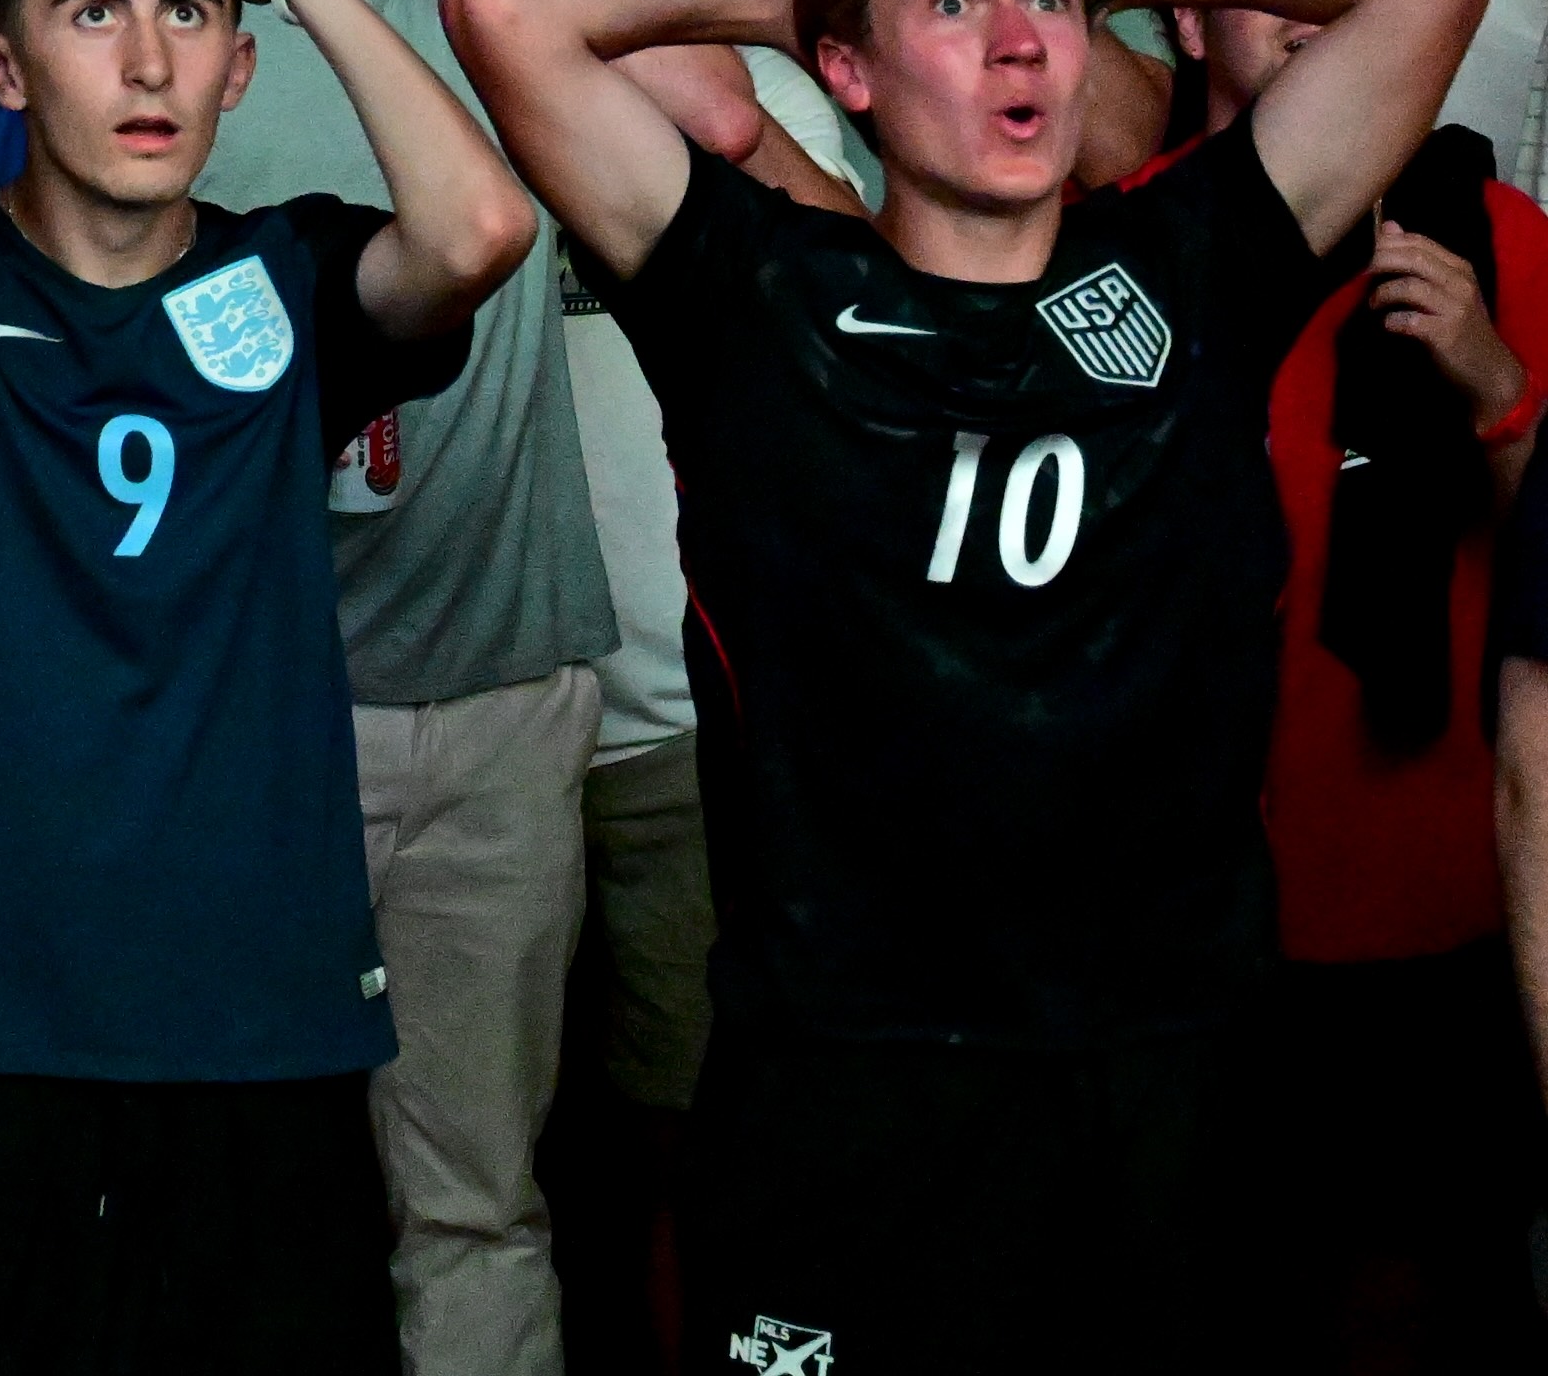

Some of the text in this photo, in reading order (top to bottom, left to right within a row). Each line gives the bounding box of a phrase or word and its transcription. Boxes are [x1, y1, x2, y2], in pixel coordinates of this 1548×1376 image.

[1054, 279, 1134, 331] USA
[97, 414, 176, 557] 9
[927, 433, 1086, 588] 10
[760, 1320, 790, 1342] MLS
